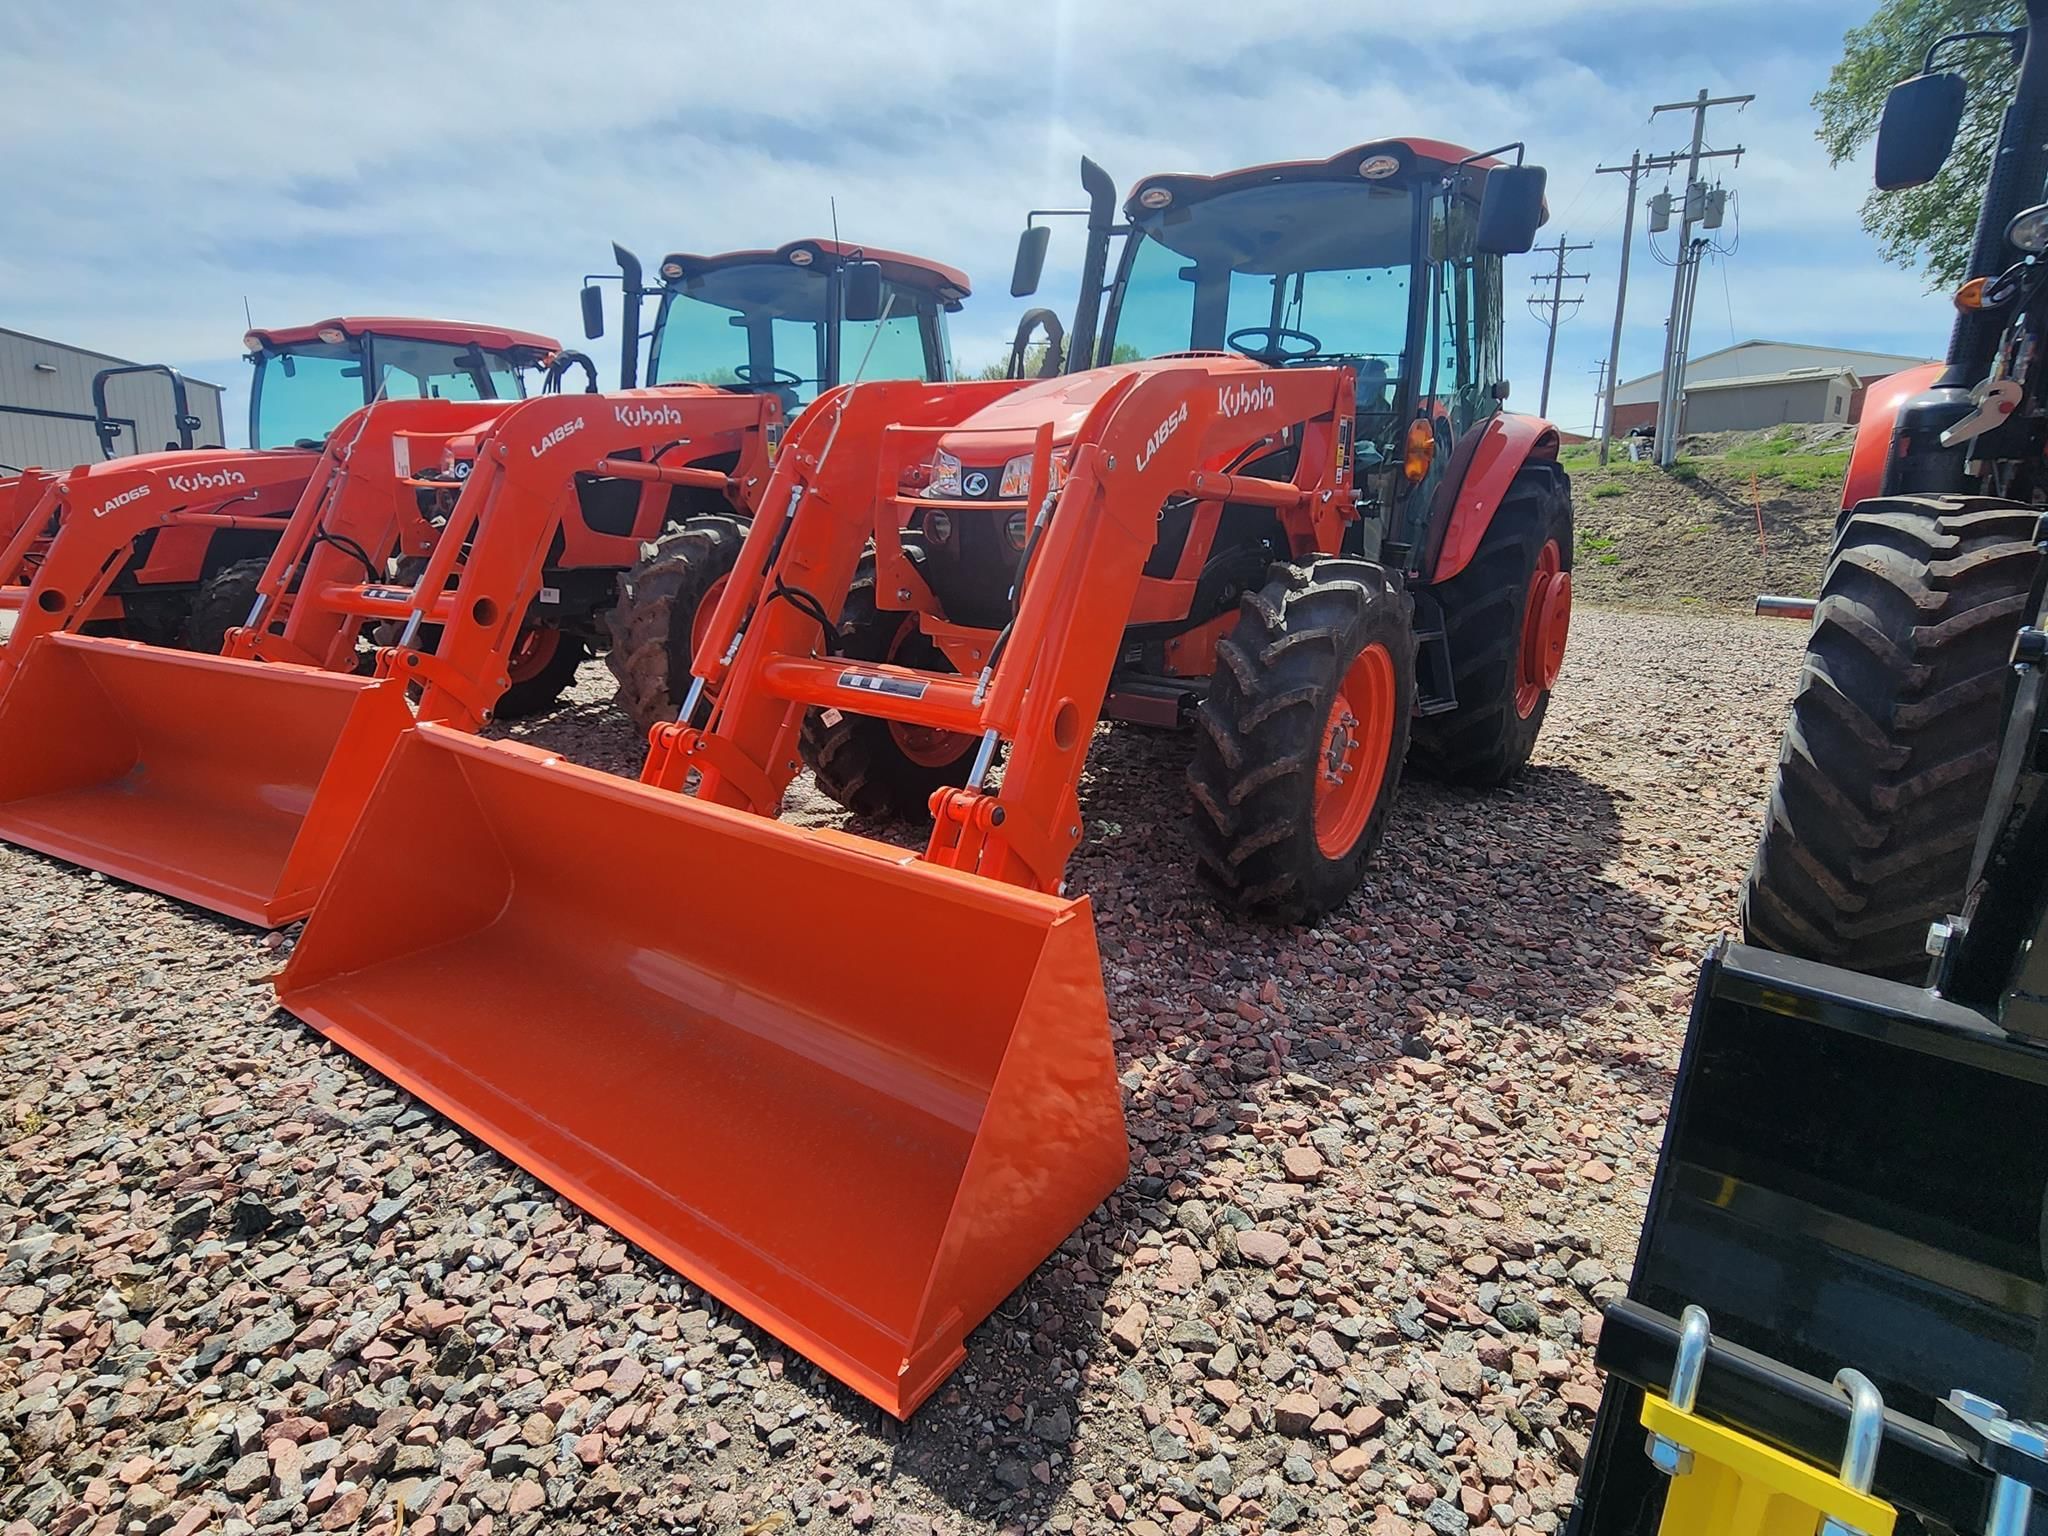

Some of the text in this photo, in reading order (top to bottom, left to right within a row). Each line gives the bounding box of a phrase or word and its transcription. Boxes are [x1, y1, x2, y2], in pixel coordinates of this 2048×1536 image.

[1219, 379, 1274, 417] Kubota
[615, 405, 681, 427] Kubota
[531, 417, 585, 457] LA1854
[1136, 402, 1188, 472] LA1854
[168, 468, 246, 492] Kubota
[93, 485, 151, 517] LA1065
